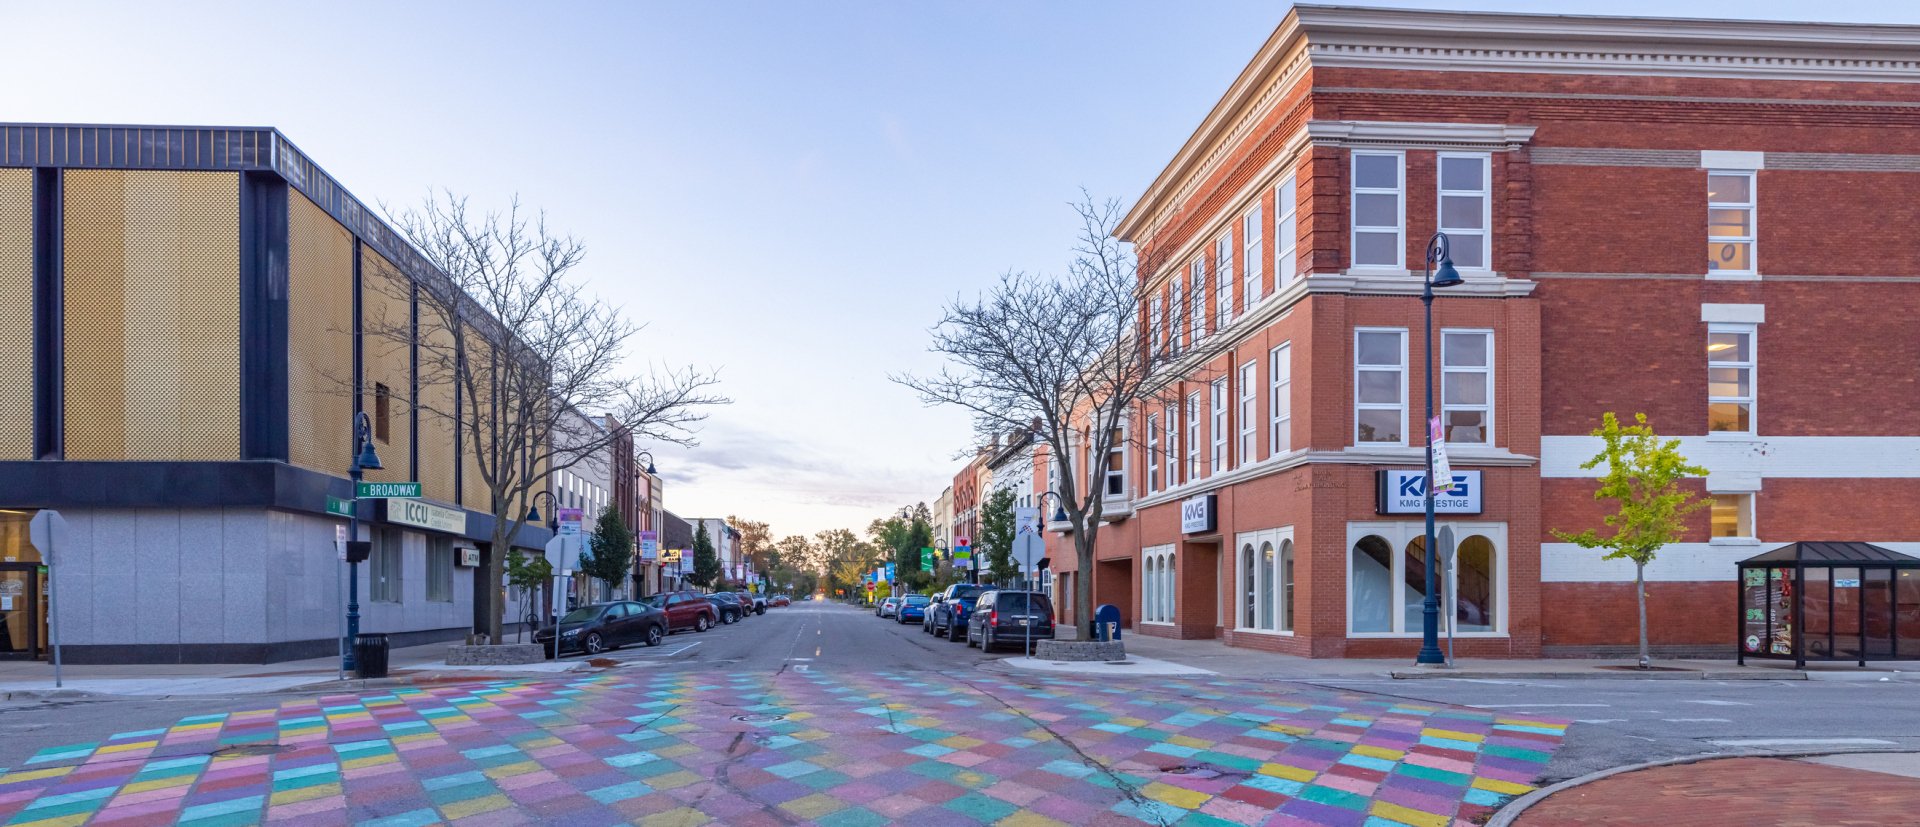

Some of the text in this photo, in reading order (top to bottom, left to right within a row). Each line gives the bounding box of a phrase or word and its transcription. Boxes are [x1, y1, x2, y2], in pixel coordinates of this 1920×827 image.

[362, 484, 416, 496] E BROADWAY
[1400, 476, 1468, 496] KG
[1185, 501, 1204, 521] KMG
[1400, 499, 1420, 508] KMG
[405, 502, 428, 524] ICCU
[468, 553, 479, 561] ATM
